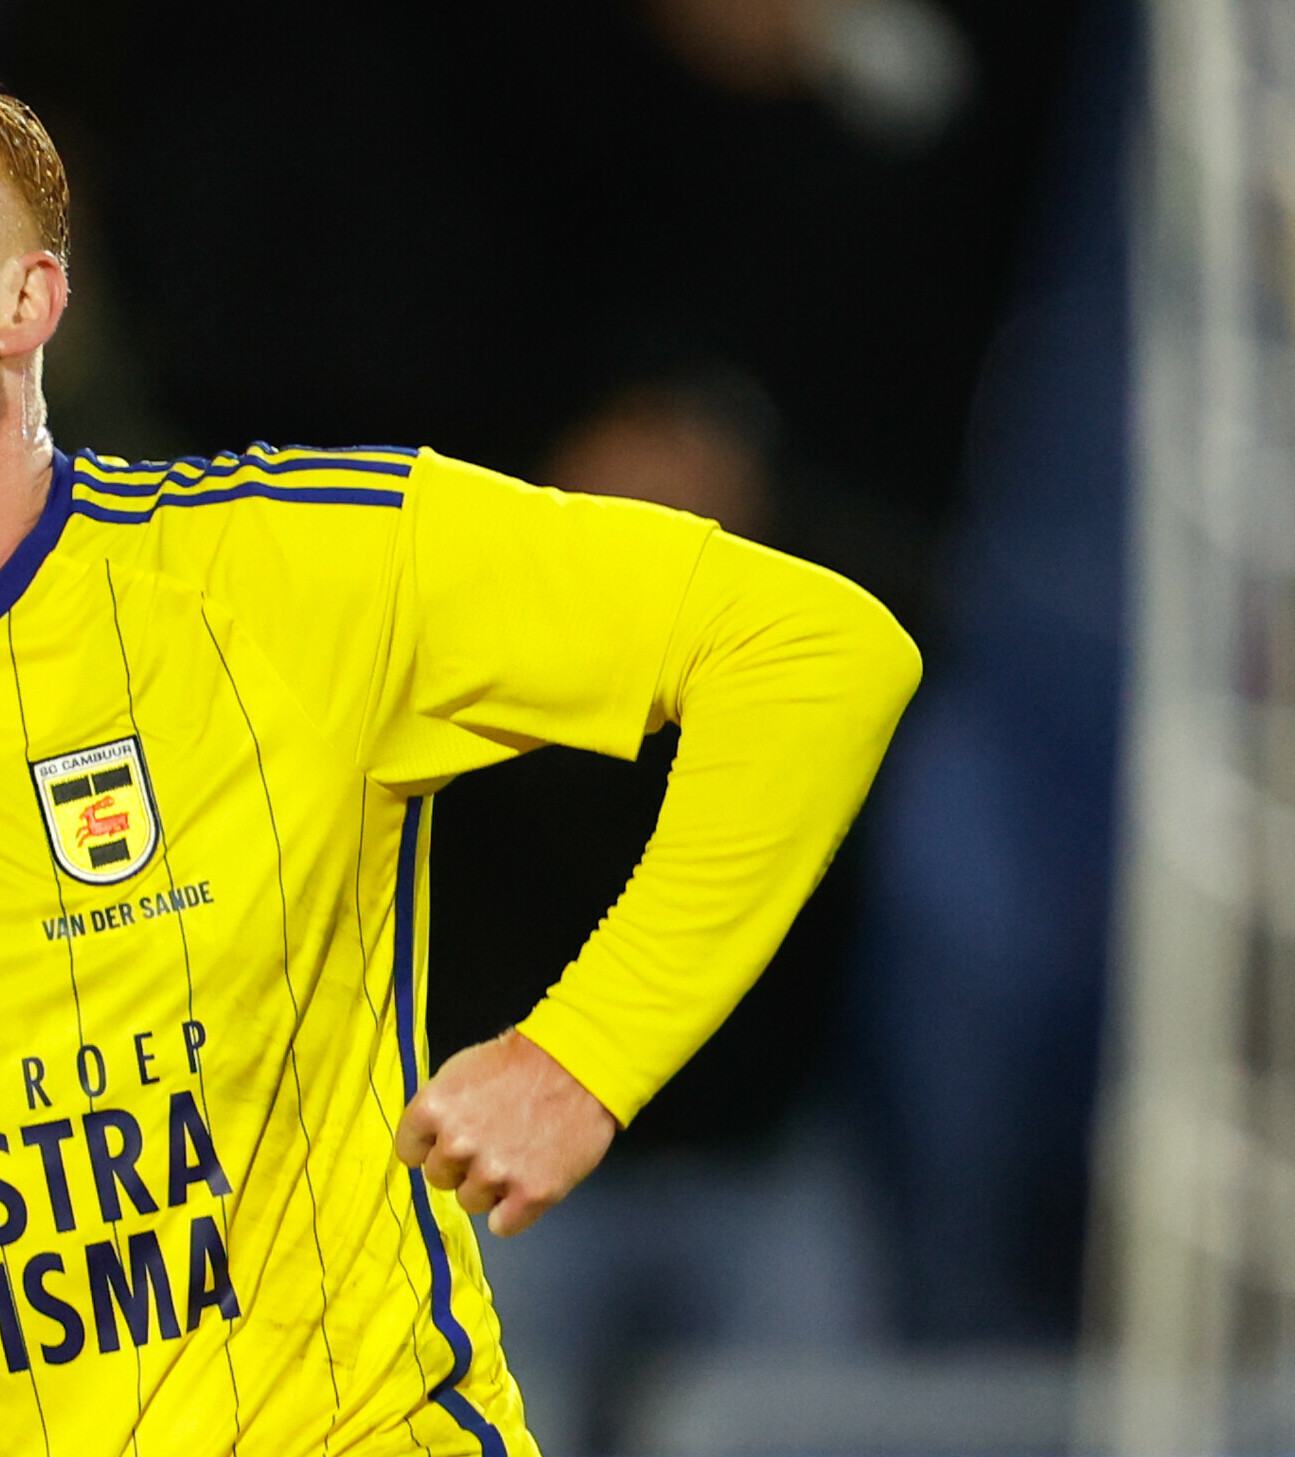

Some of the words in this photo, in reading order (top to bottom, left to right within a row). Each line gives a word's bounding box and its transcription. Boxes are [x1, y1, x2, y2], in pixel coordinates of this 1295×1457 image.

[62, 744, 132, 771] CAMBUUR
[42, 913, 86, 941] VAN
[90, 903, 135, 932] DER
[139, 881, 214, 919] SANDE
